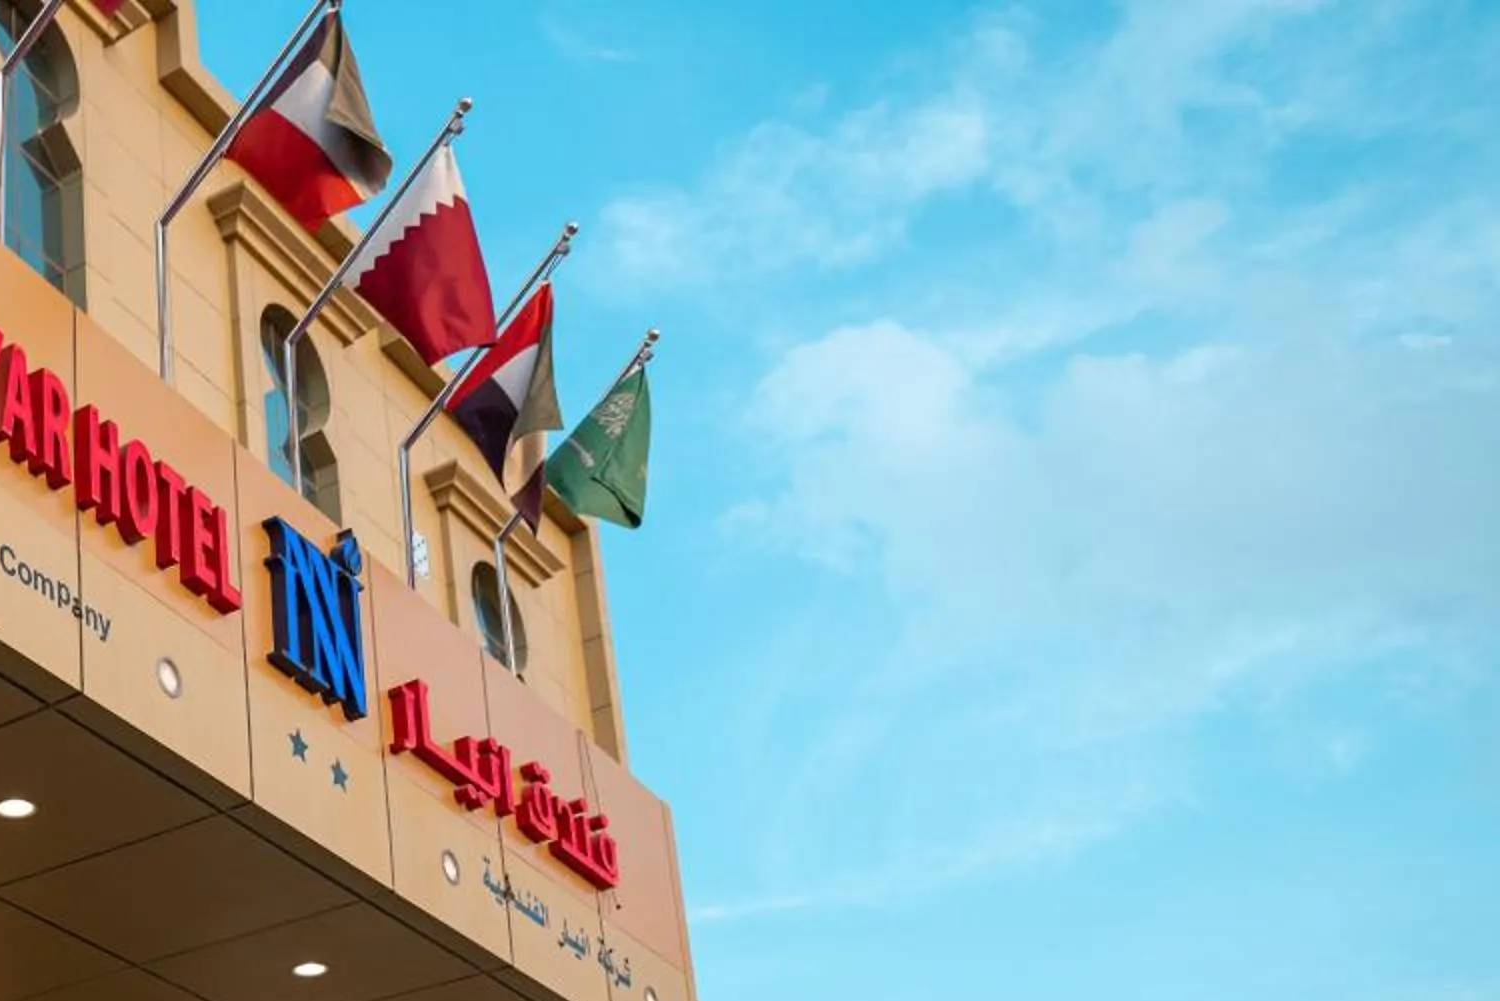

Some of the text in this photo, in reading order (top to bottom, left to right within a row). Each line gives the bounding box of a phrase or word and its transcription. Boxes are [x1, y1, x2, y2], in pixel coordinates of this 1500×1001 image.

[73, 403, 242, 616] HOTEL
[0, 544, 111, 641] Company
[515, 761, 620, 892] فندق
[482, 855, 549, 929] الفندقية
[597, 936, 631, 988] شركة
